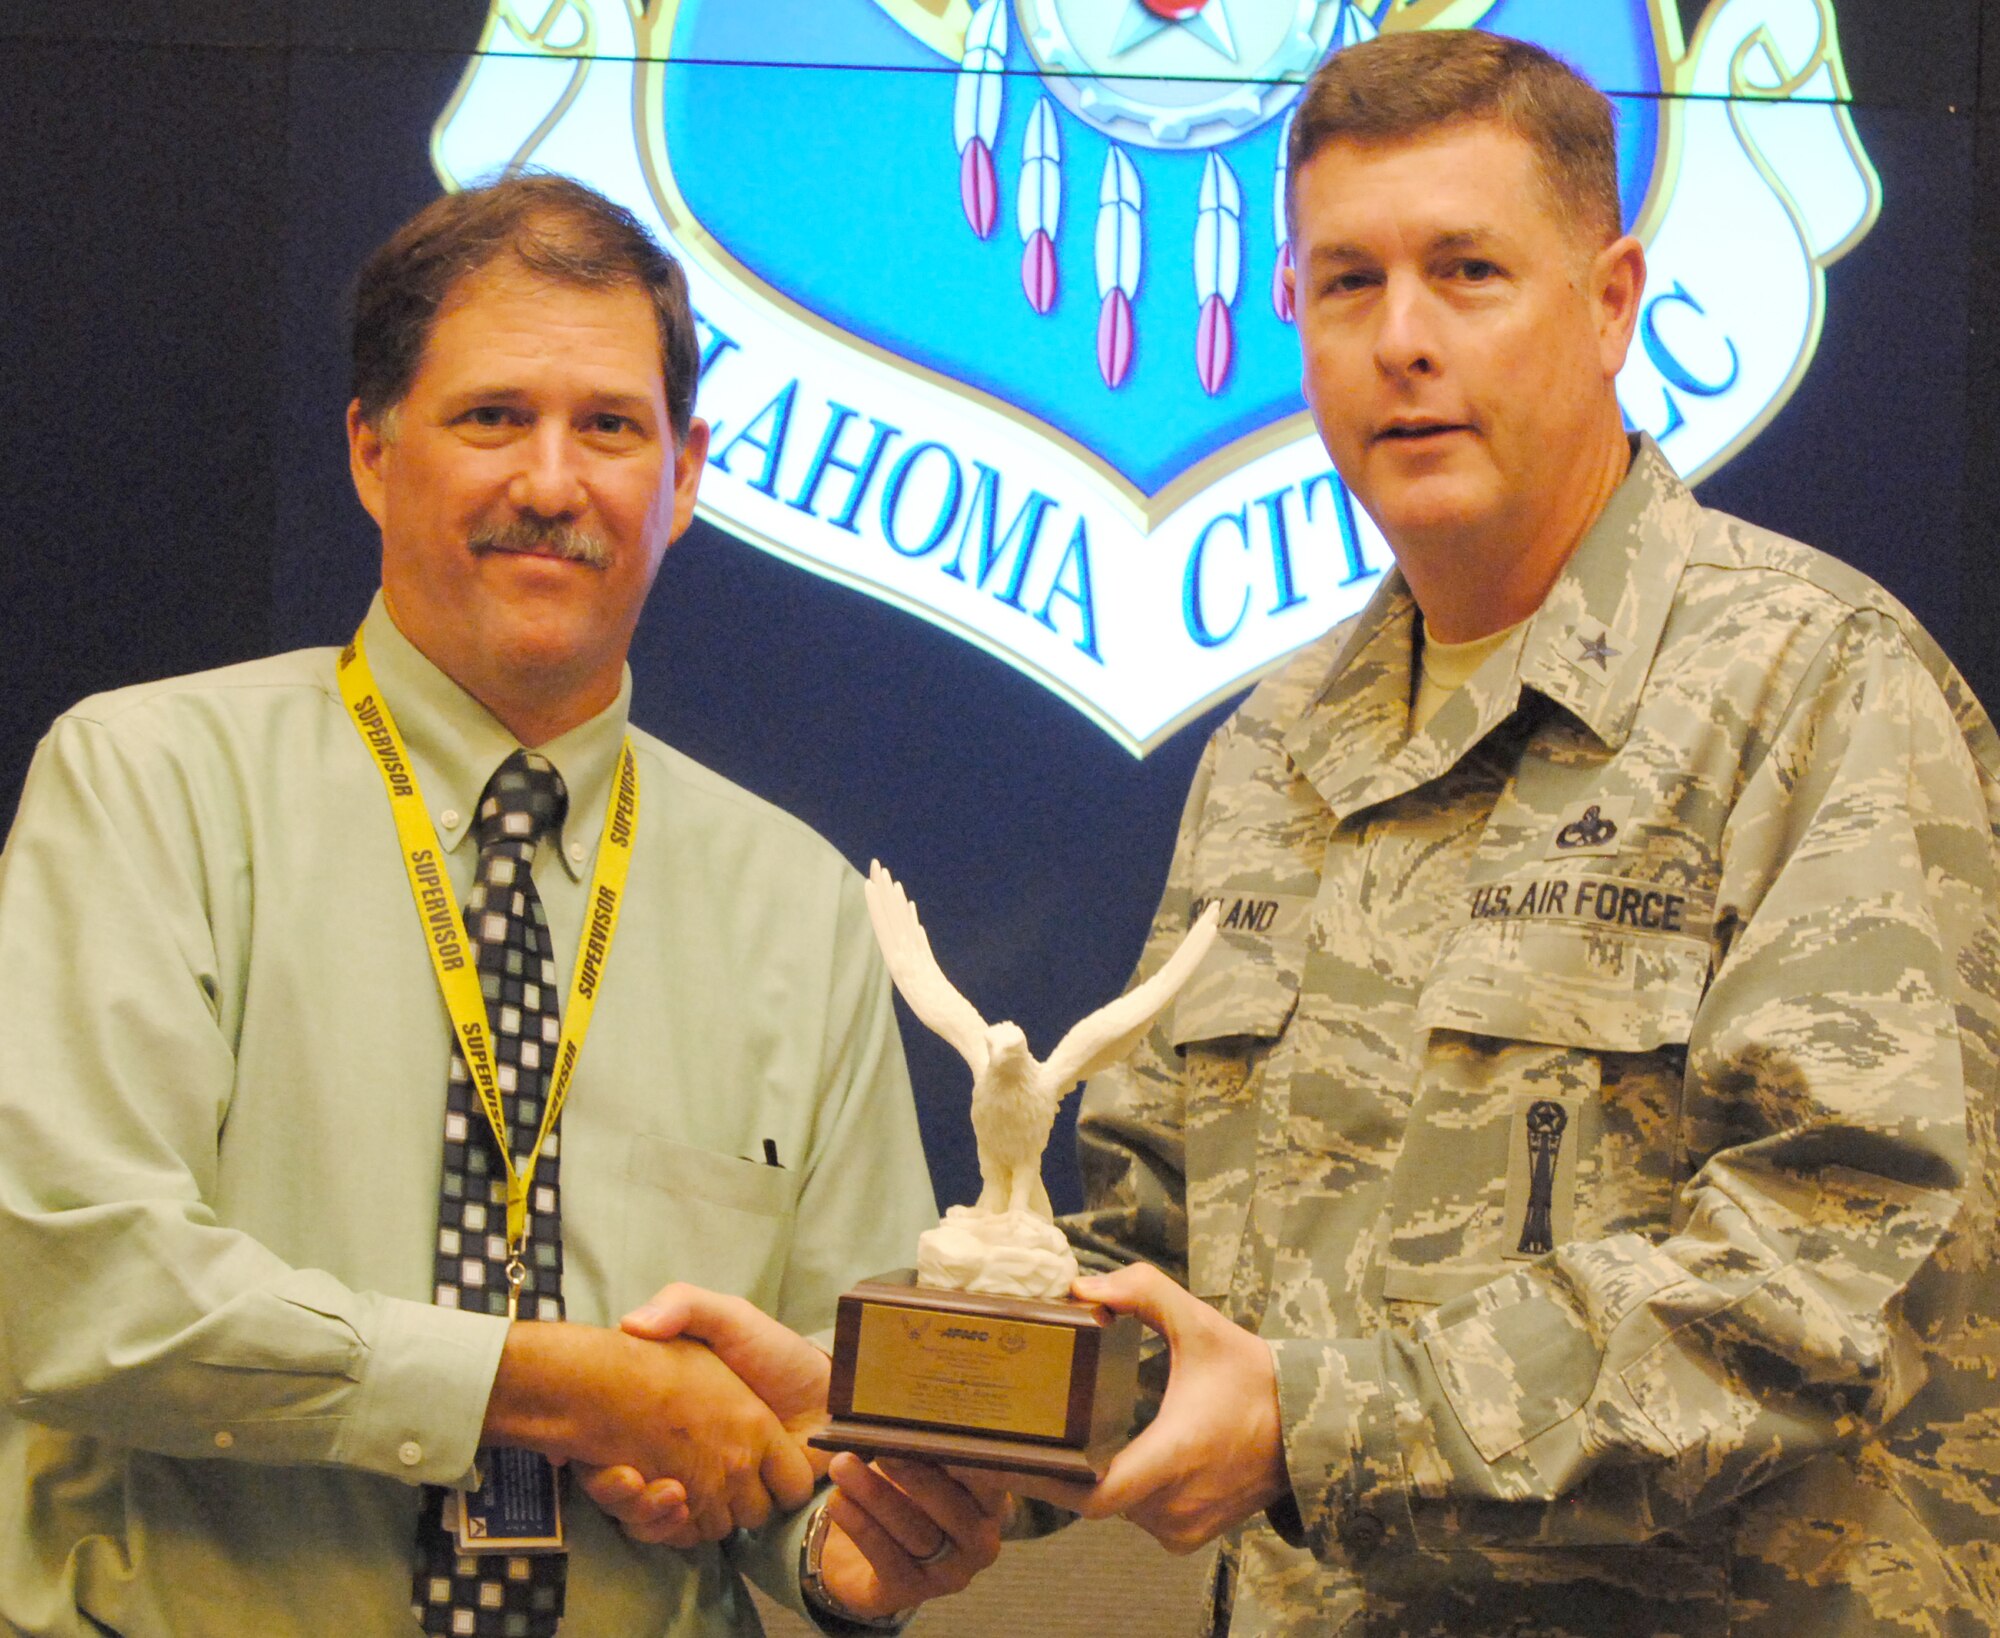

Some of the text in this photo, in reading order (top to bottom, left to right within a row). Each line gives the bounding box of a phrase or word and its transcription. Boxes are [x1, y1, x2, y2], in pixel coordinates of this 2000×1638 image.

[1181, 469, 1381, 649] CIT
[354, 695, 413, 796] SUPERVISOR
[412, 849, 464, 972] SUPERVISOR
[578, 885, 617, 1000] SUPERVISOR
[1516, 880, 1568, 916] AIR
[1574, 881, 1684, 932] FORCE
